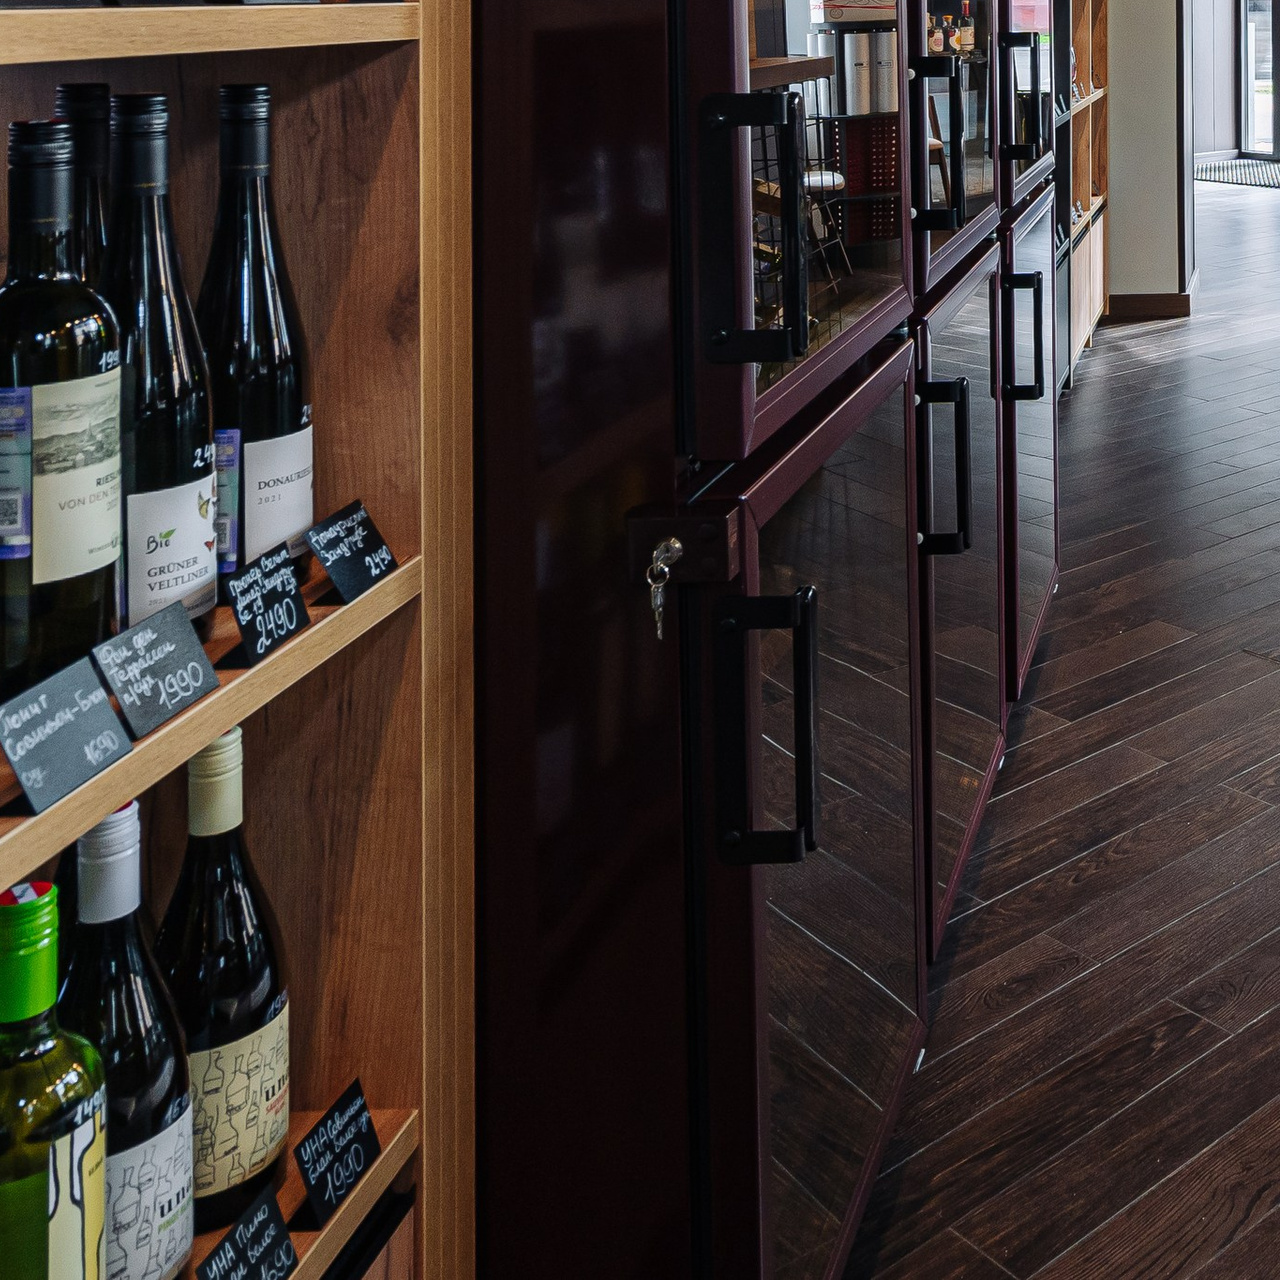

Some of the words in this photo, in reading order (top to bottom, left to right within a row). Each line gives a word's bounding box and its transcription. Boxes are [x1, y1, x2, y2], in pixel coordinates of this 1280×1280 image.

[58, 496, 87, 511] VON
[257, 494, 282, 505] 2021
[145, 534, 171, 555] Bio
[364, 544, 393, 577] 2490
[146, 555, 199, 578] GRÜNER
[147, 565, 210, 593] VELTLINER
[255, 598, 298, 654] 2490
[158, 661, 204, 710] 1990
[300, 1126, 329, 1168] УНА
[324, 1141, 366, 1205] 1990
[207, 1241, 236, 1280] УНА
